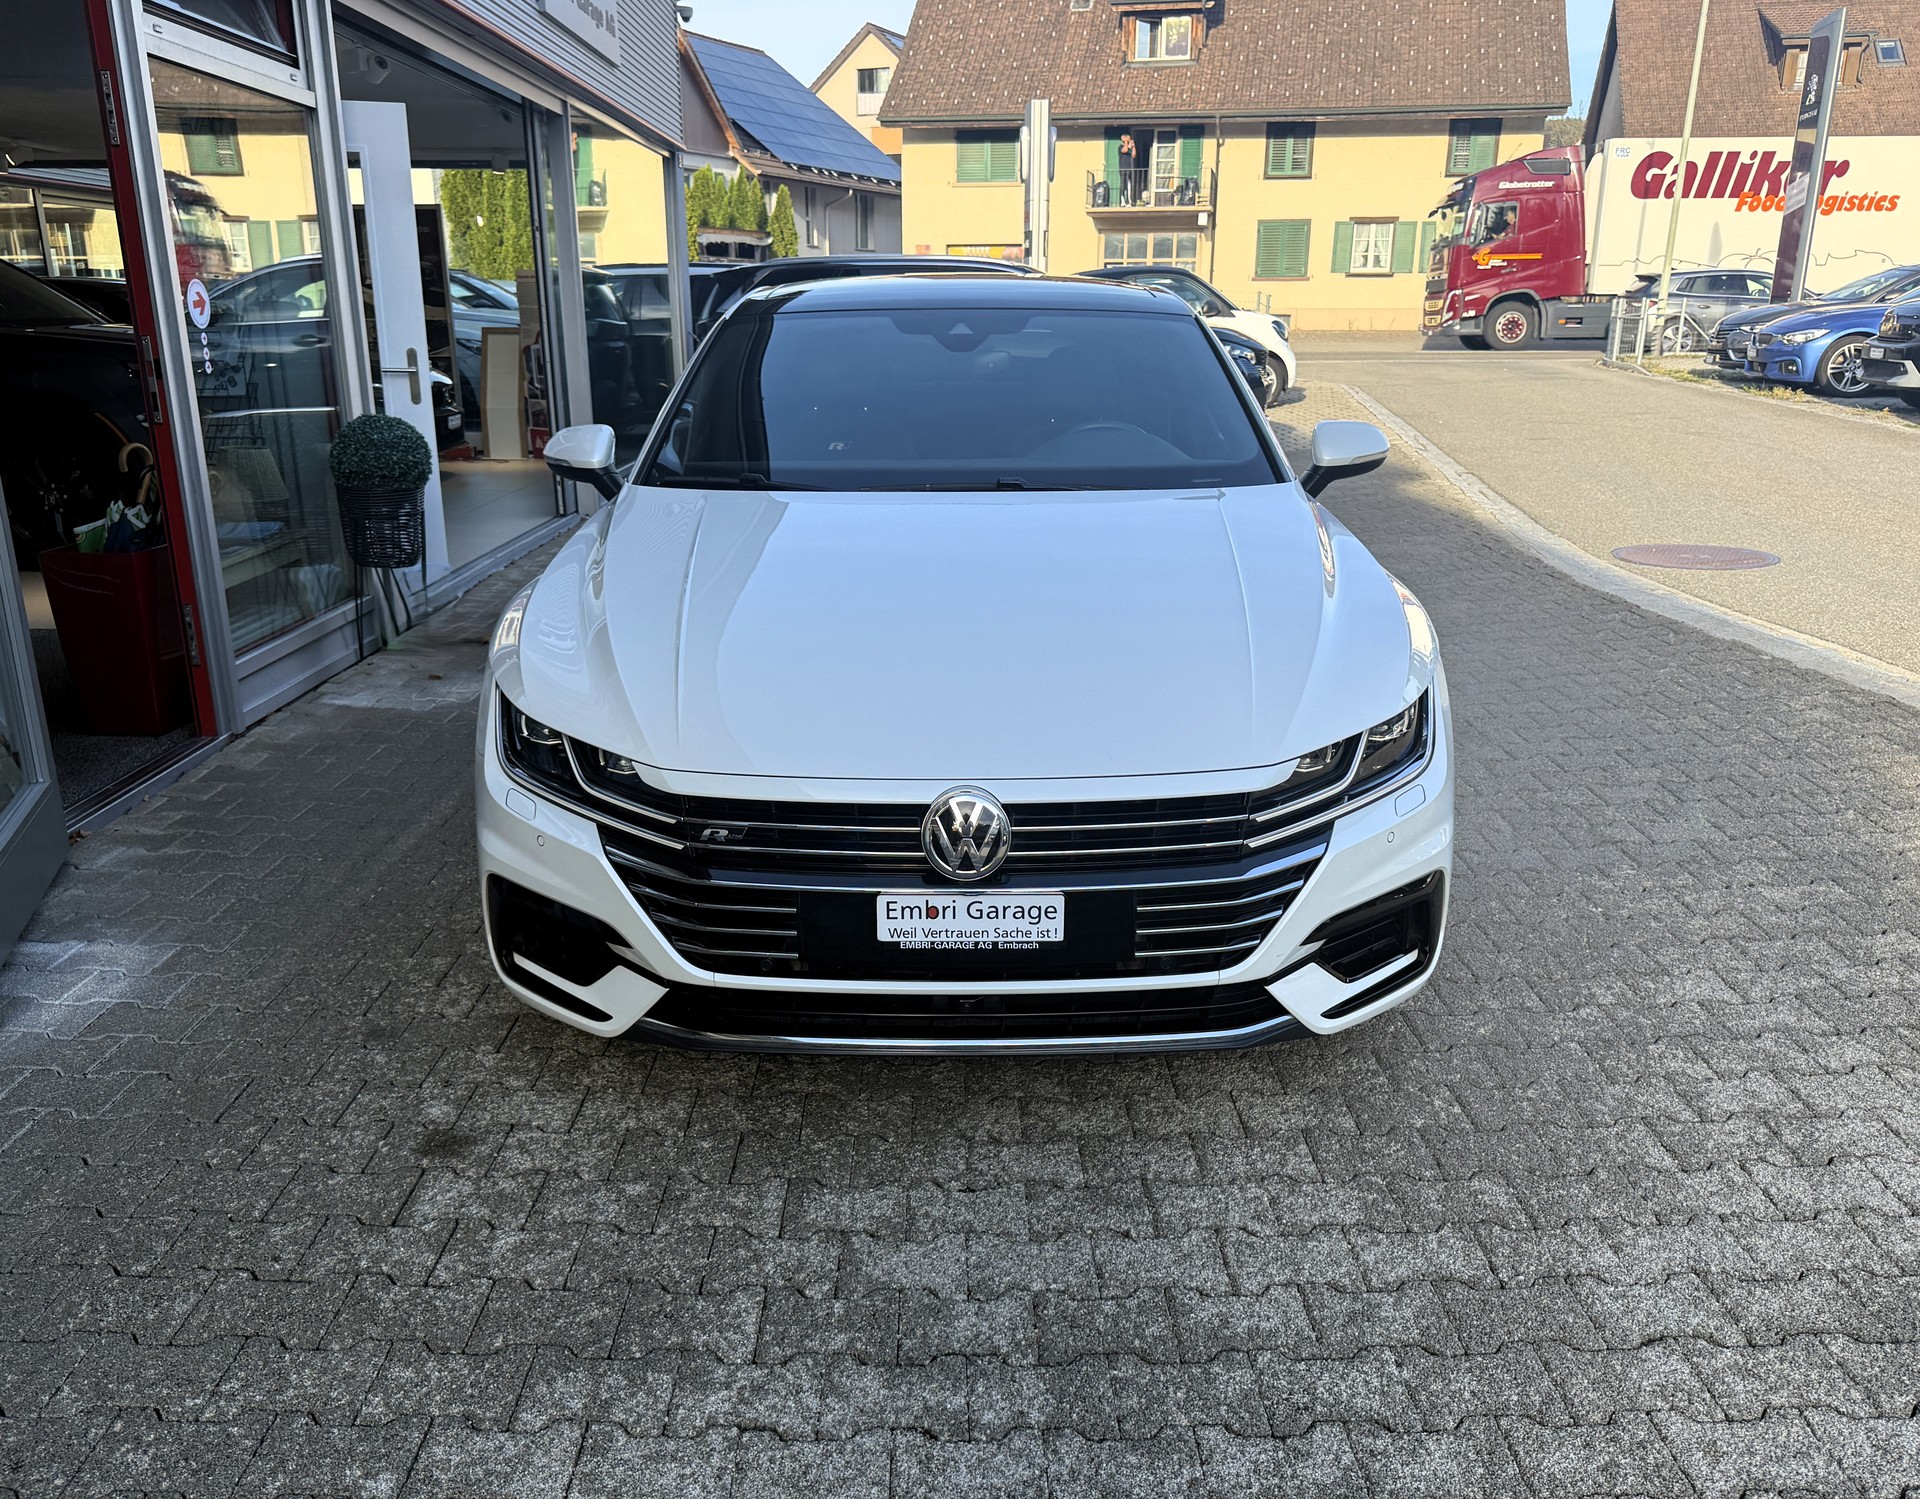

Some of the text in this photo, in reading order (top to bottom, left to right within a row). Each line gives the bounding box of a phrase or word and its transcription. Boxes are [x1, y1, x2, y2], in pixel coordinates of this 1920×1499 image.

[605, 9, 616, 38] AG
[1498, 181, 1555, 189] Globetrotter
[1630, 150, 1850, 200] Gallikr
[1817, 191, 1901, 216] gistics
[886, 900, 1058, 925] Embri Garage
[888, 927, 917, 939] Weil
[921, 927, 990, 939] Vertrauen
[993, 927, 1033, 939] Sache
[900, 941, 1039, 949] EMBRI-GARAGE AG Embrach
